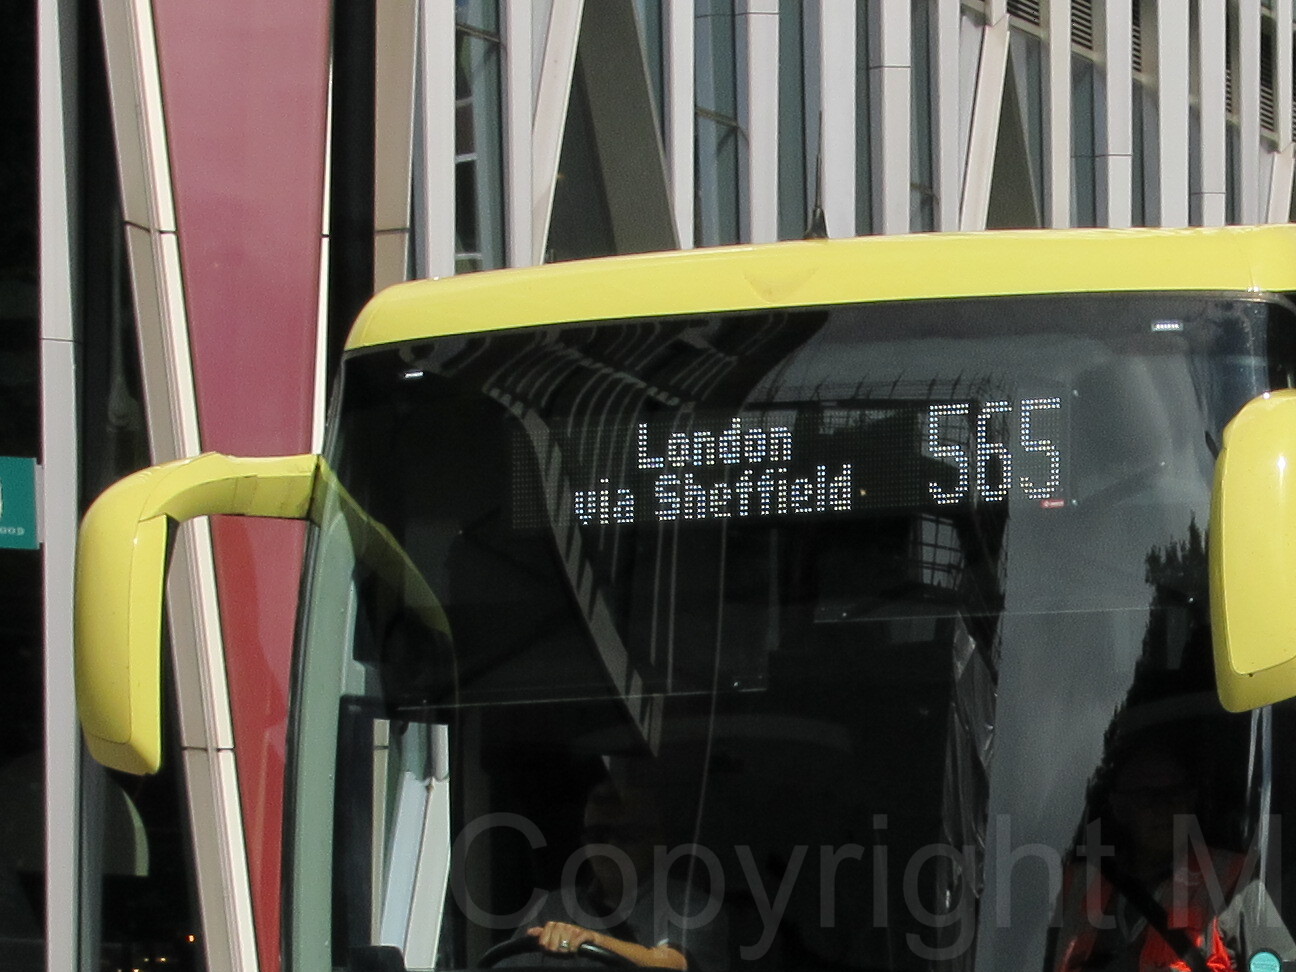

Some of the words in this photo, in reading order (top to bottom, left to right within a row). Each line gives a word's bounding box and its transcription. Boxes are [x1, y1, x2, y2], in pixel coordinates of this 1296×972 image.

[637, 417, 793, 469] London
[928, 397, 1062, 504] 565
[575, 479, 635, 525] via
[654, 463, 852, 521] Sheffield
